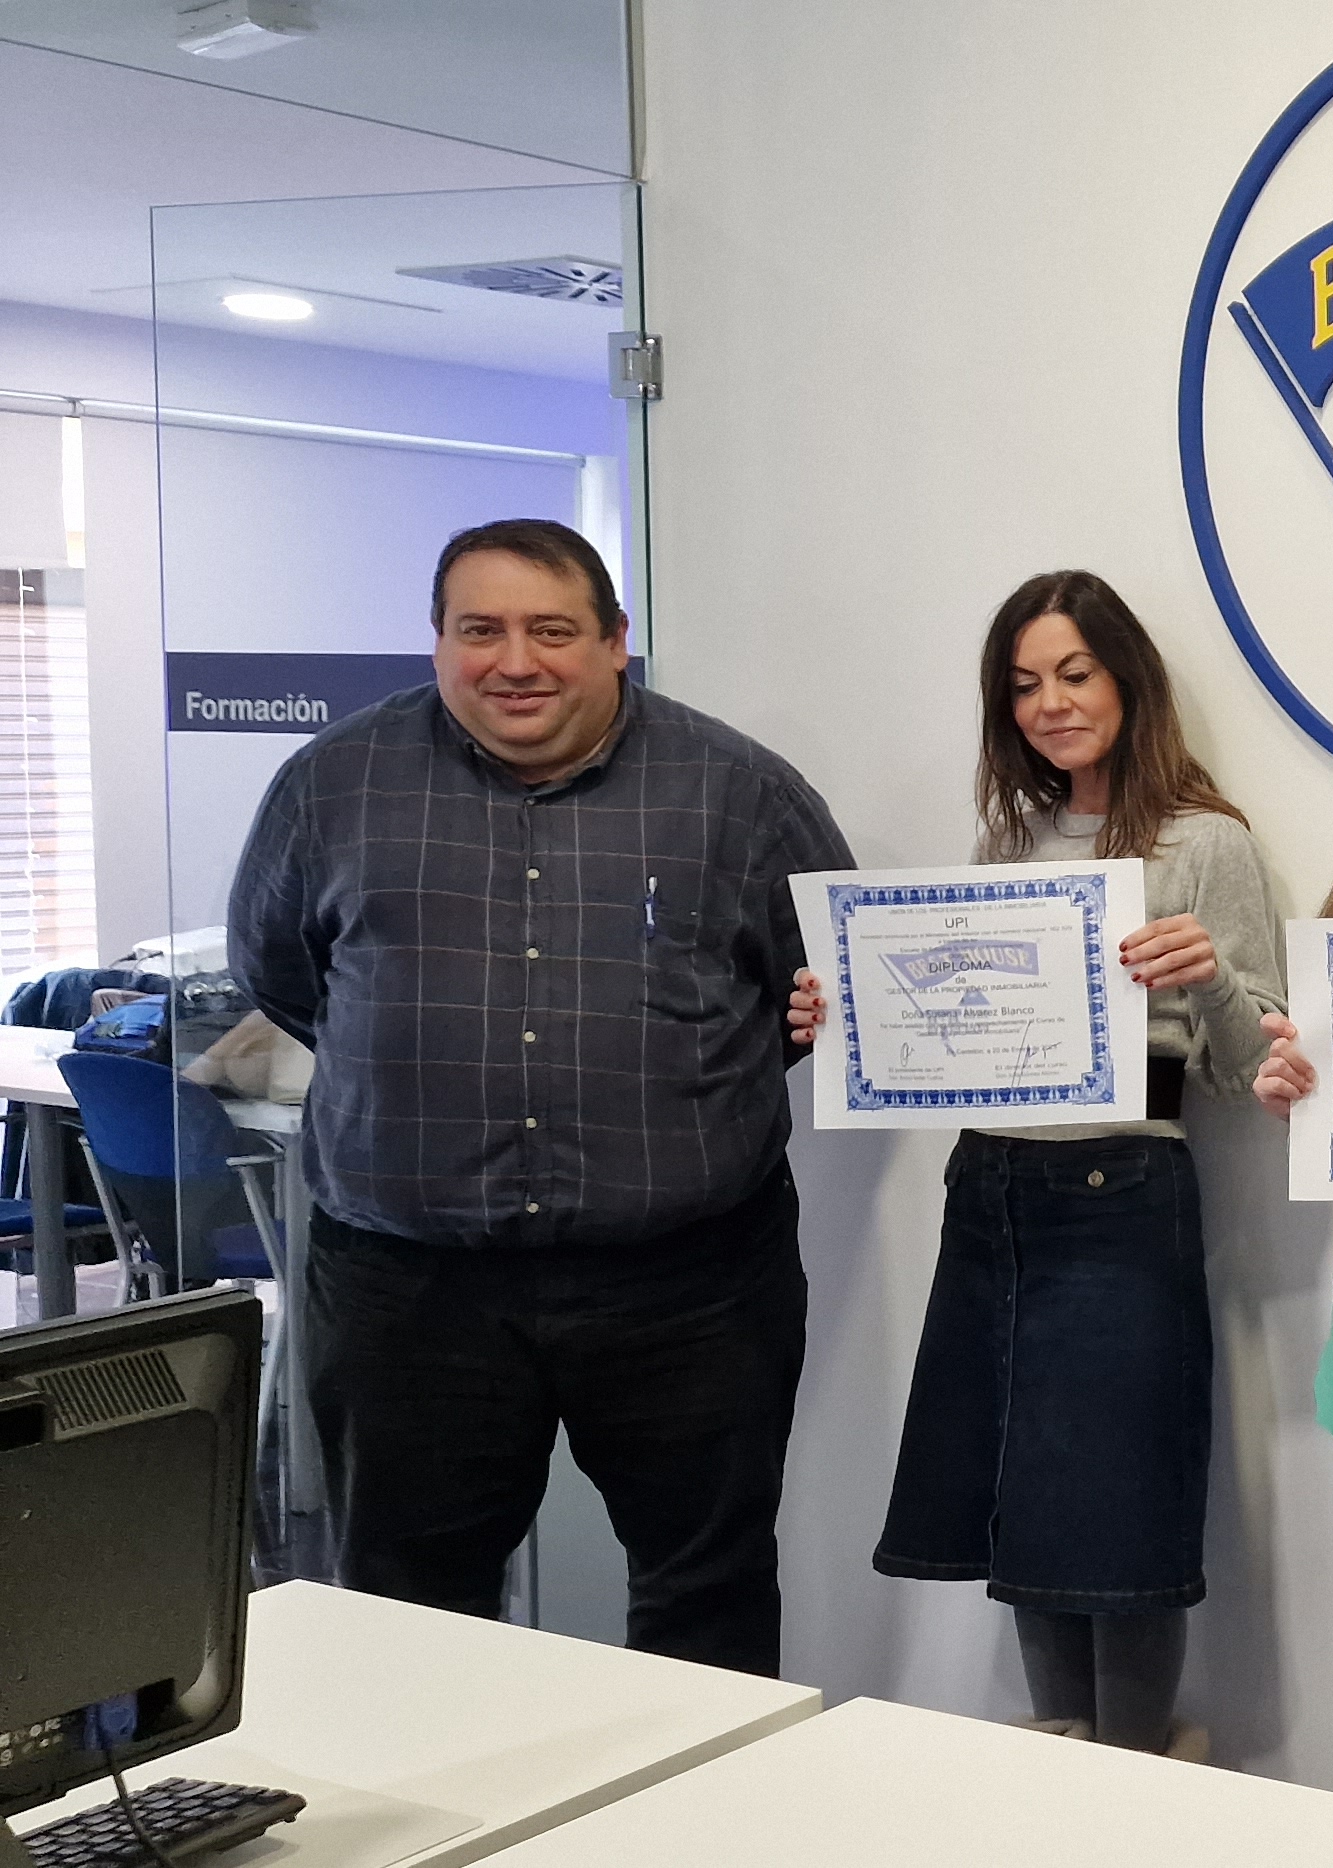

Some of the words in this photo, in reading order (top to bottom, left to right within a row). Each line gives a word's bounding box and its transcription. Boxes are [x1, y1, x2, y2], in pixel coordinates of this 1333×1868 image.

[185, 690, 329, 723] Formación
[944, 917, 969, 928] UPI
[929, 961, 993, 973] DIPLOMA
[955, 976, 967, 984] de
[918, 986, 928, 994] DE
[1001, 1006, 1035, 1016] Blanco
